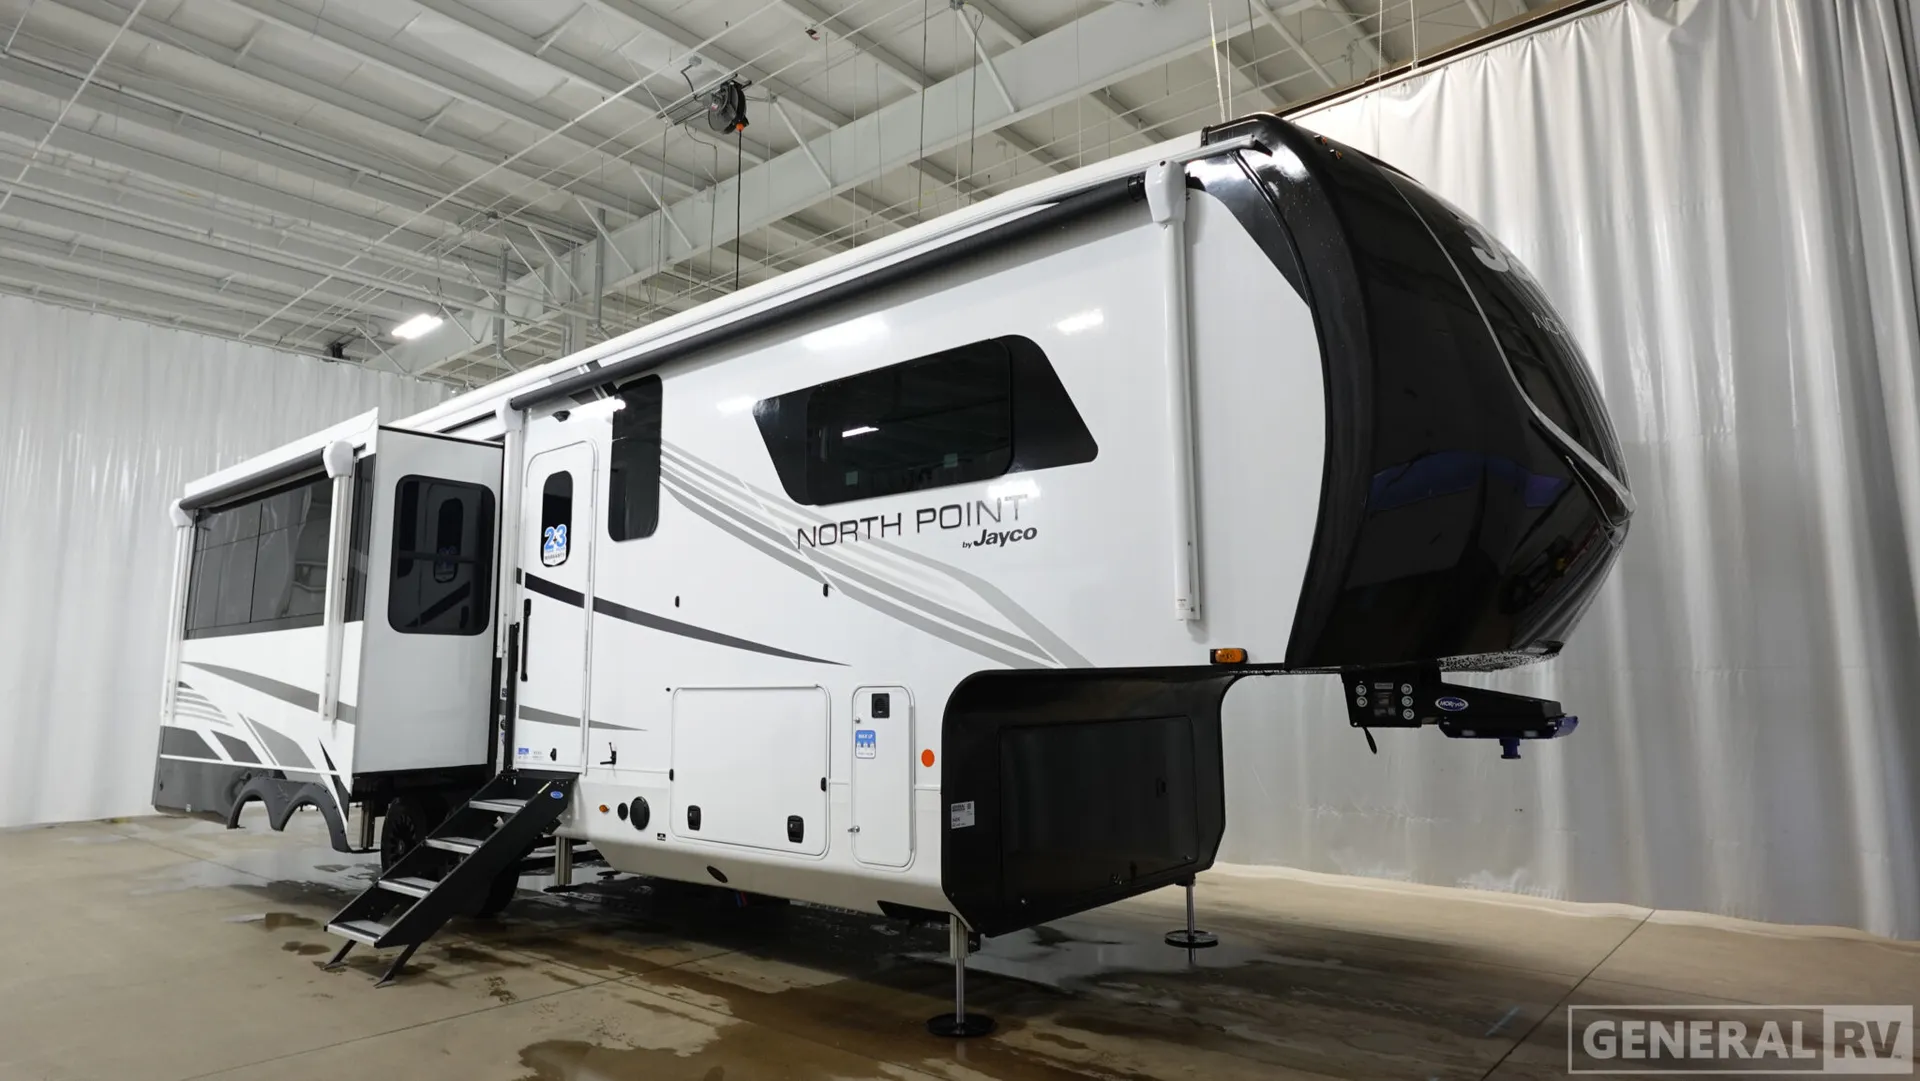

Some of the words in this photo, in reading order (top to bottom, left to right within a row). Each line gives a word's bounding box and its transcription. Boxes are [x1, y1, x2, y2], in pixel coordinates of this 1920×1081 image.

[797, 512, 902, 550] NORTH
[916, 494, 1028, 533] POINT
[962, 541, 973, 549] by
[973, 527, 1037, 548] Jayco
